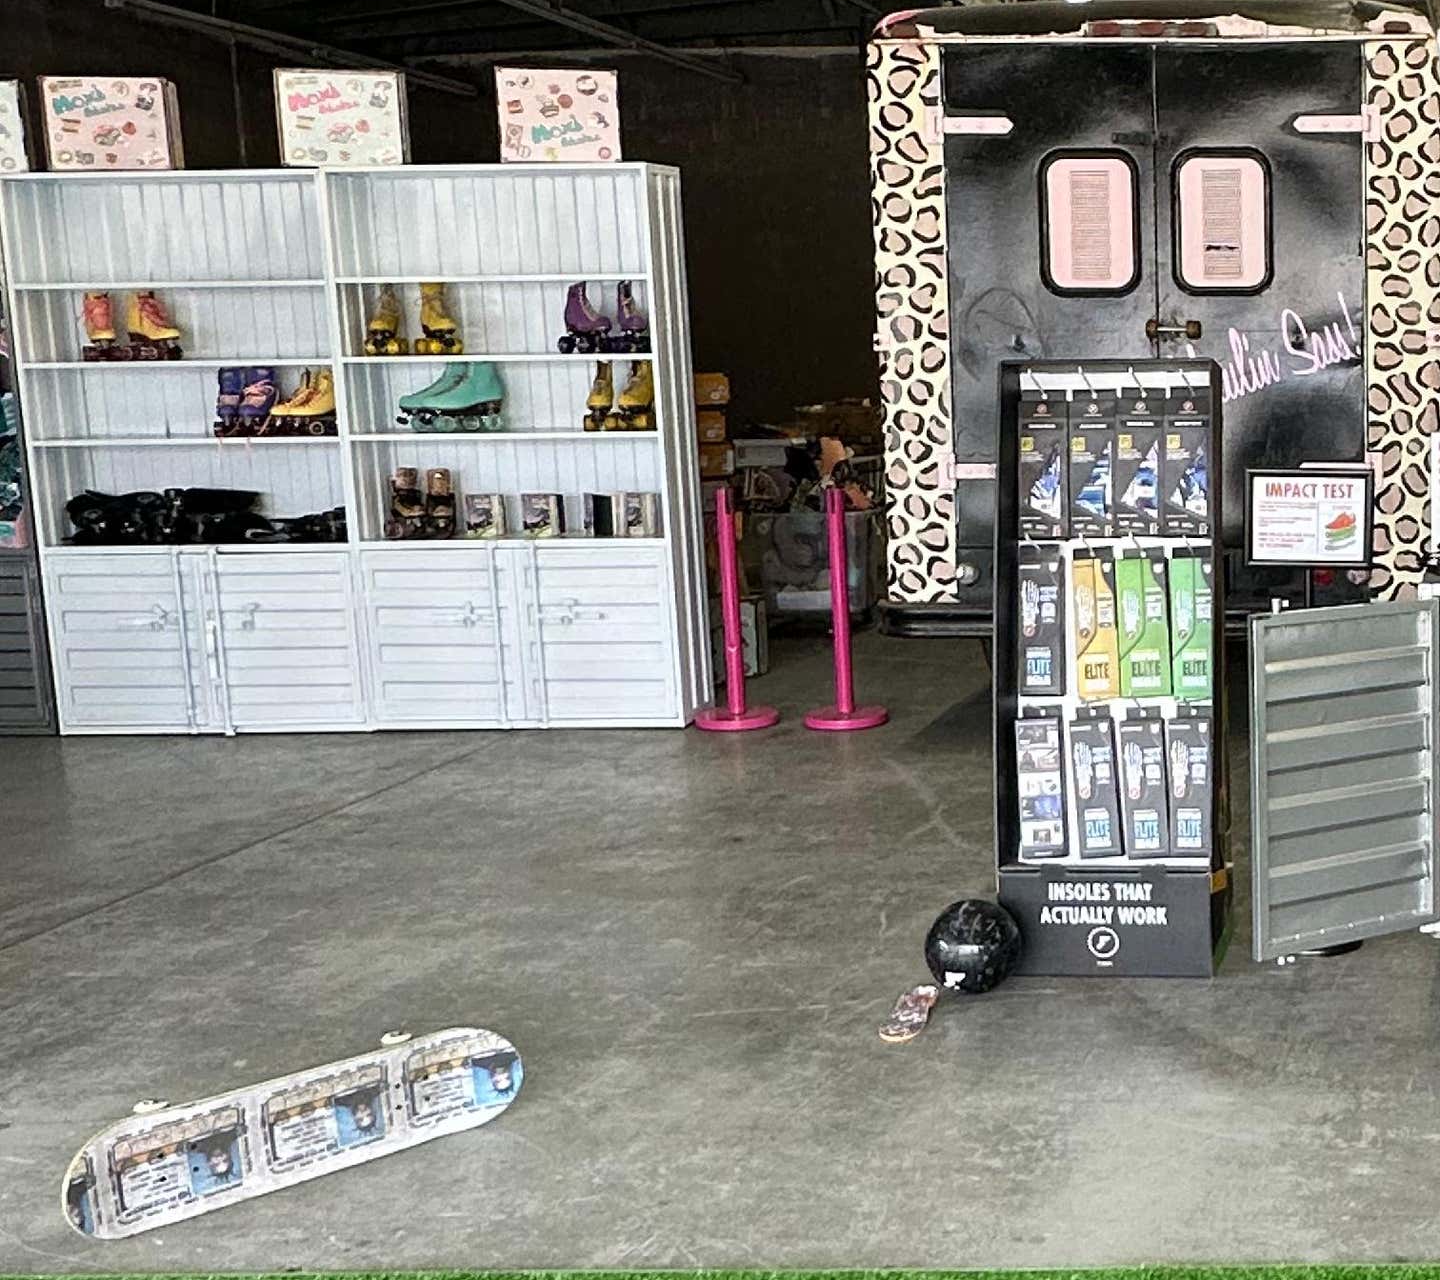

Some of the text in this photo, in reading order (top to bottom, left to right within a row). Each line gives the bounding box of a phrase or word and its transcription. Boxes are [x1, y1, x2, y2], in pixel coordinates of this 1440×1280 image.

[1265, 482, 1354, 499] IMPACT TEST
[1084, 663, 1110, 680] ELITE
[1132, 660, 1161, 677] ELITE
[1183, 659, 1207, 677] ELITE
[1048, 882, 1153, 901] INSOLES THAT
[1040, 906, 1167, 925] ACTUALLY WORK
